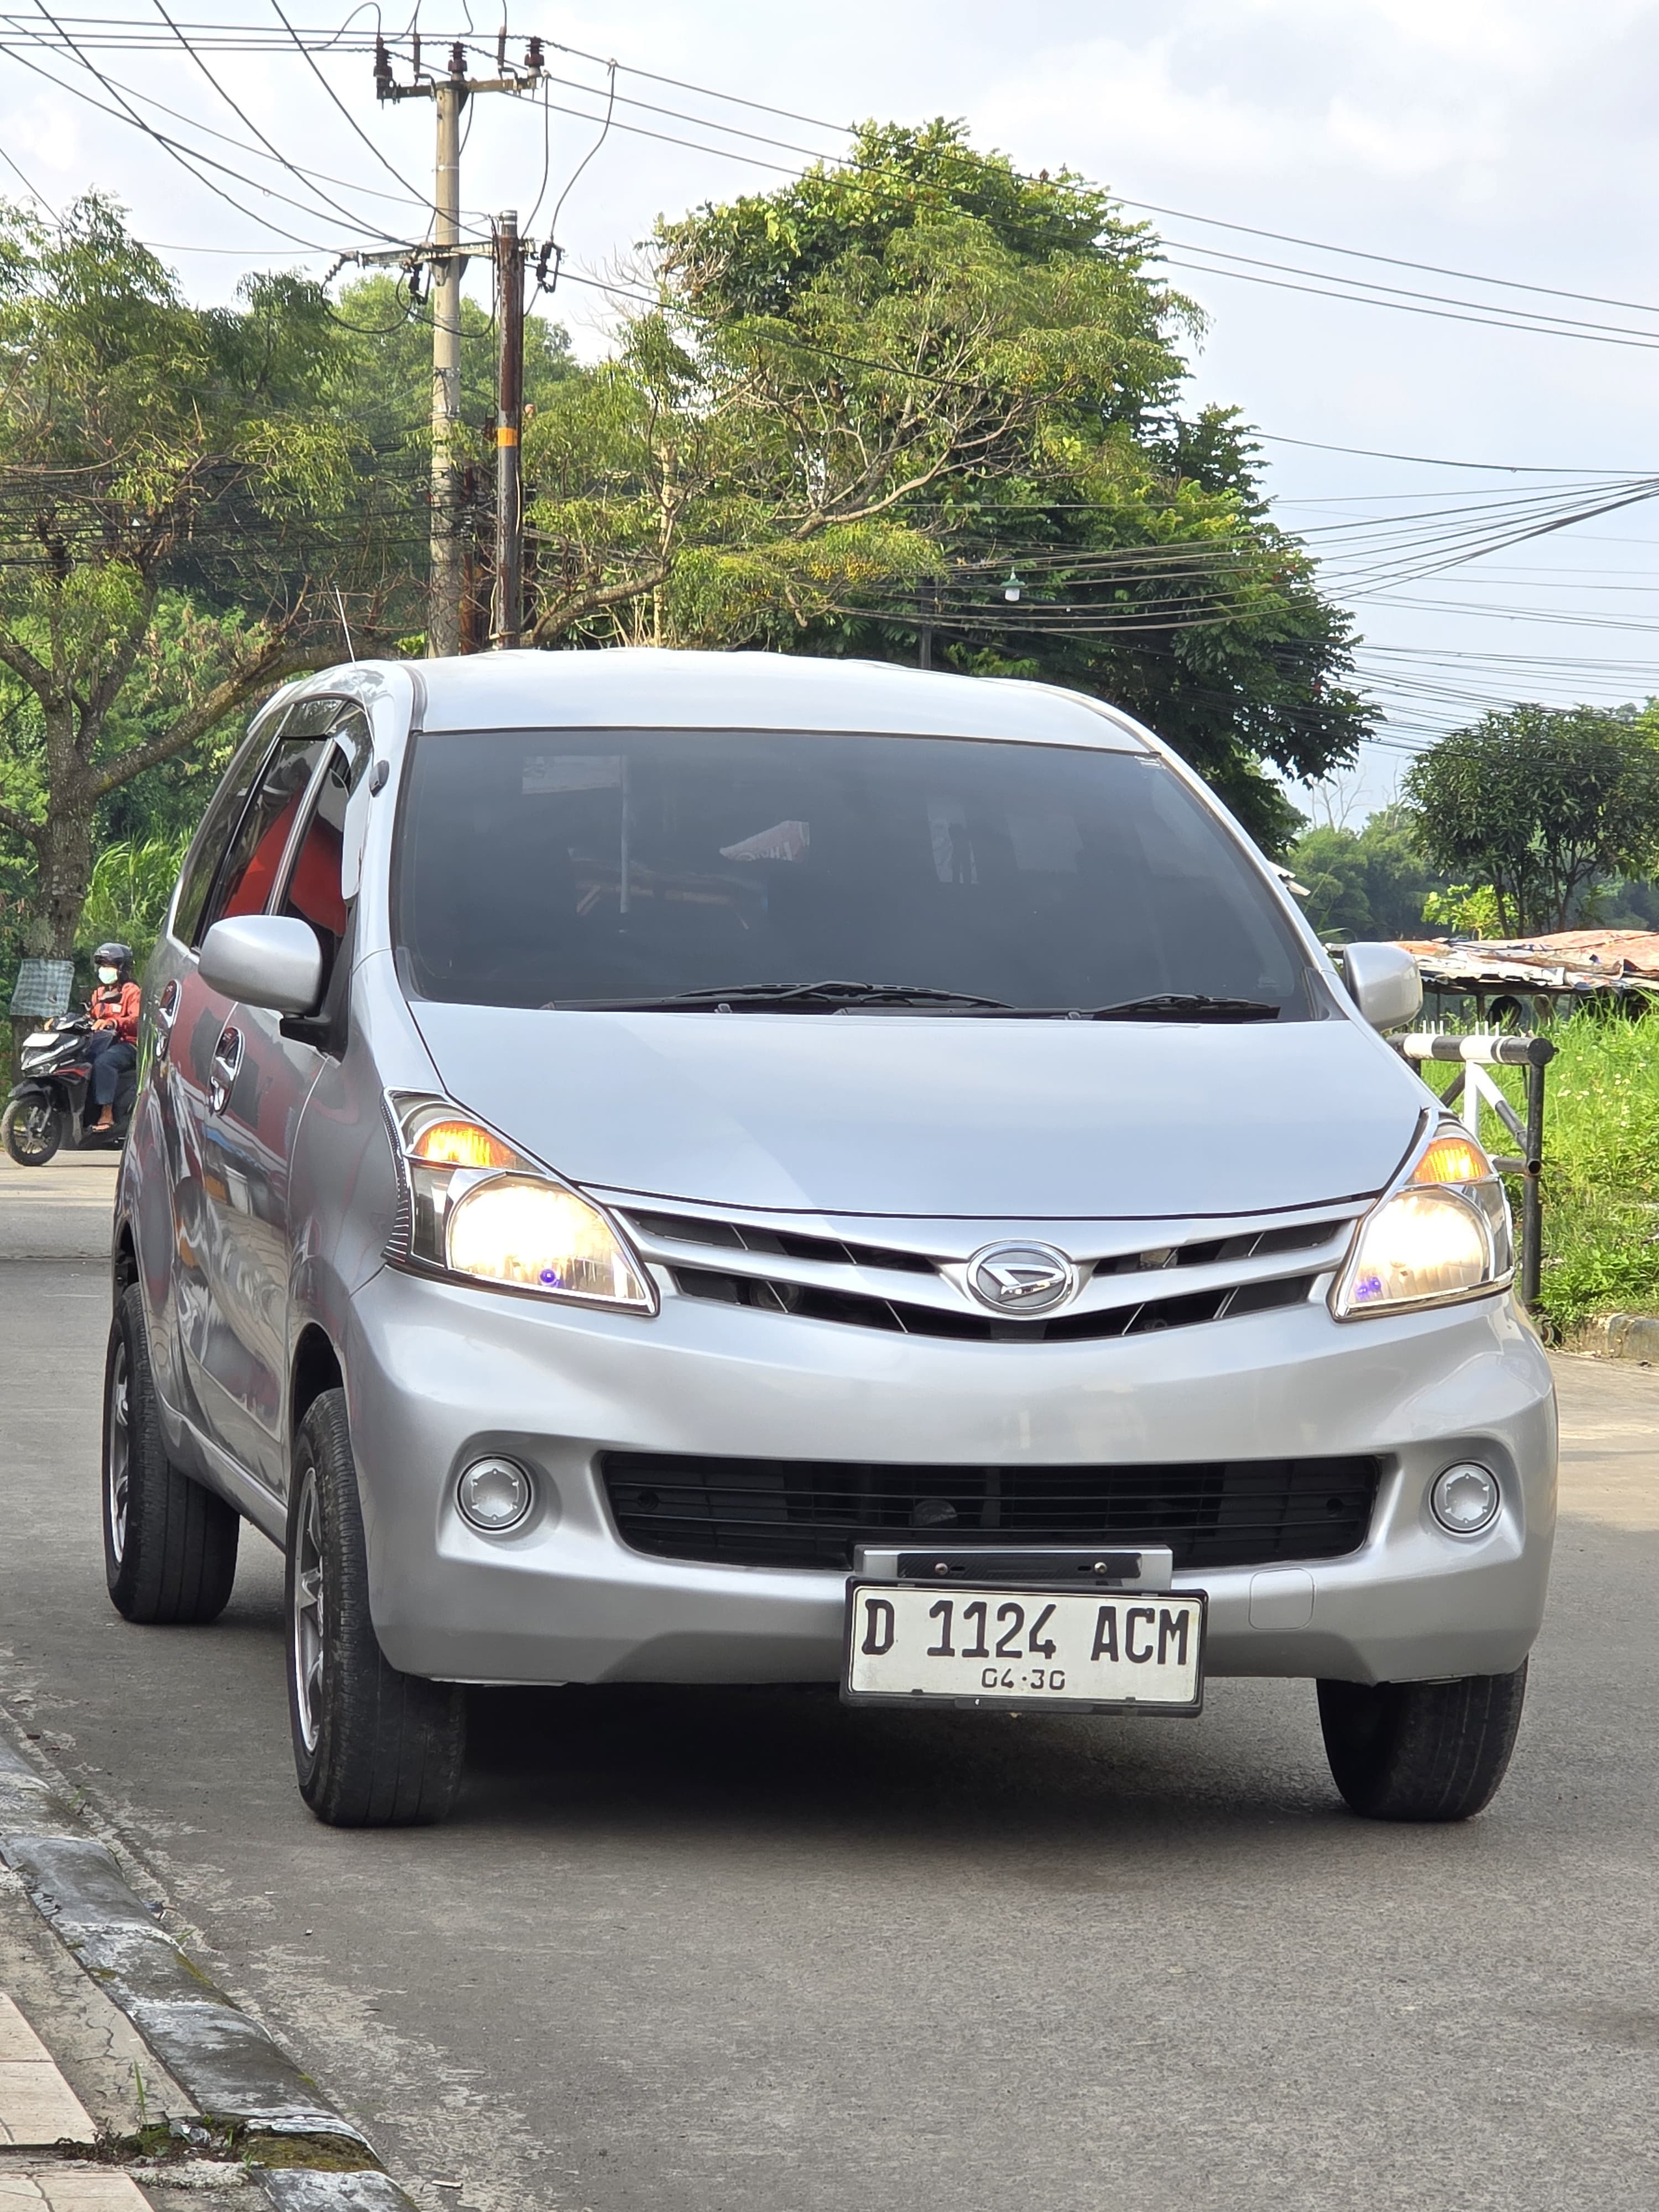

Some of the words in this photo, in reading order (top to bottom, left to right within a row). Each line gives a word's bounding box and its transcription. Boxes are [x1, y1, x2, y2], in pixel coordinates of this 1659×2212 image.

[861, 1598, 895, 1656] D
[927, 1600, 1057, 1660] 1124
[1091, 1606, 1190, 1666] ACM
